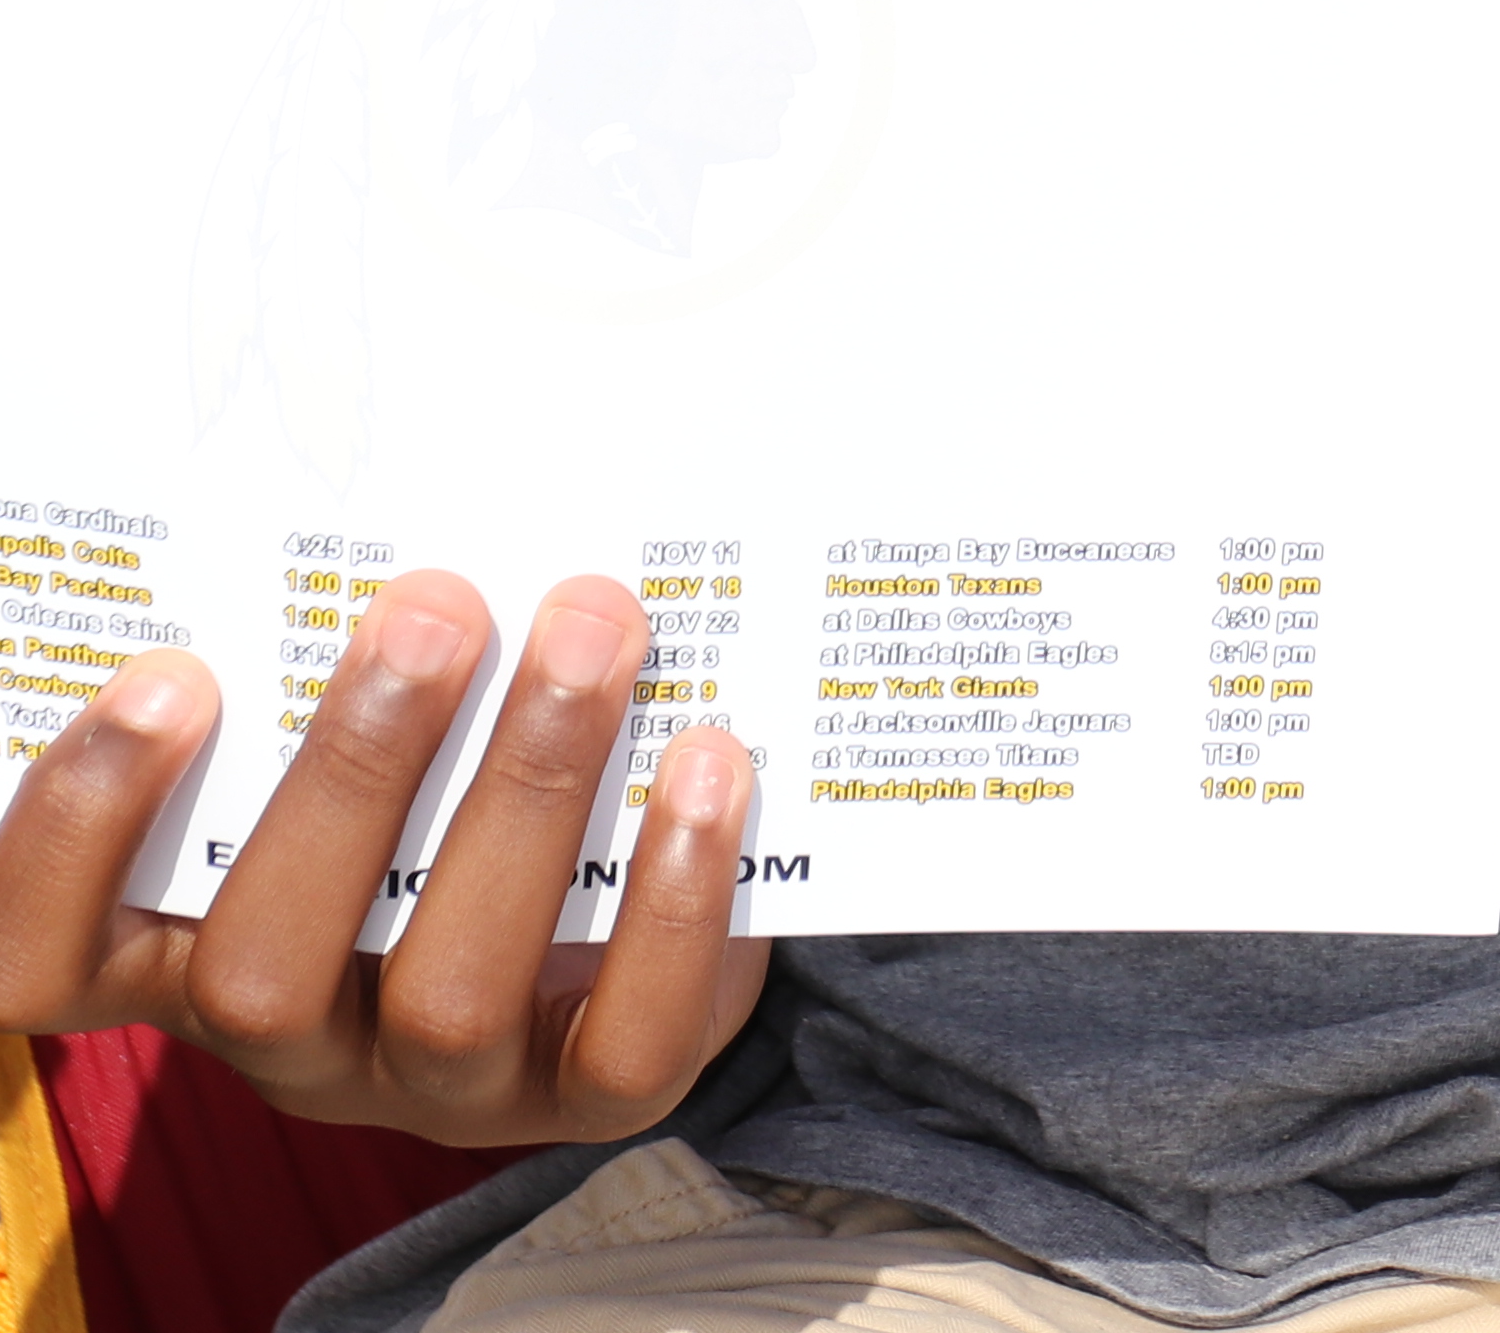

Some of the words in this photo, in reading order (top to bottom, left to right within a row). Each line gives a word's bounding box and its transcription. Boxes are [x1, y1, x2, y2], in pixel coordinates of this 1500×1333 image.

[45, 502, 167, 540] Cardinals
[284, 533, 342, 559] 4:25
[349, 540, 393, 565] pm
[643, 542, 706, 565] NOV
[713, 541, 740, 564] 11
[828, 541, 856, 563] at
[862, 540, 950, 566] Tampa
[957, 539, 1010, 566] Bay
[1017, 539, 1175, 561] Buccaneers
[1220, 538, 1275, 560] 1:00
[1282, 543, 1323, 565] pm
[72, 540, 140, 570] Colts
[284, 568, 341, 595] 1:00
[640, 577, 704, 600] NOV
[710, 576, 742, 599] 18
[826, 574, 940, 597] Houston
[947, 573, 1042, 596] Texans
[1217, 572, 1273, 595] 1:00
[1279, 577, 1321, 600] pm
[50, 571, 153, 606] Packers
[283, 604, 340, 631] 1:00
[706, 611, 739, 634] 22
[823, 610, 851, 632] at
[857, 608, 940, 631] Dallas
[947, 608, 1071, 634] Cowboys
[1212, 607, 1270, 629] 4:30
[1276, 611, 1318, 634] pm
[2, 604, 102, 633] Orleans
[110, 614, 190, 646] Saints
[280, 640, 338, 667] 8:15
[703, 646, 719, 668] 3
[820, 644, 848, 666] at
[854, 642, 1020, 669] Philadelphia
[1028, 641, 1118, 668] Eagles
[1210, 641, 1267, 663] 8:15
[1273, 646, 1315, 668] pm
[634, 681, 691, 703] DEC
[700, 680, 717, 702] 9
[818, 678, 878, 700] New
[883, 676, 944, 699] York
[951, 675, 1039, 698] Giants
[1209, 675, 1265, 698] 1:00
[1271, 680, 1313, 702] pm
[3, 703, 60, 731] York
[631, 716, 691, 739] DEC
[815, 713, 843, 734] at
[848, 710, 1017, 734] Jacksonville
[1022, 711, 1131, 737] Jaguars
[1206, 709, 1262, 731] 1:00
[1268, 714, 1309, 736] pm
[812, 747, 841, 768] at
[846, 746, 989, 768] Tennessee
[996, 744, 1078, 766] Titans
[1202, 743, 1259, 765] TBD
[810, 778, 976, 805] Philadelphia
[983, 777, 1074, 804] Eagles
[1200, 777, 1256, 799] 1:00
[1262, 782, 1304, 804] pm
